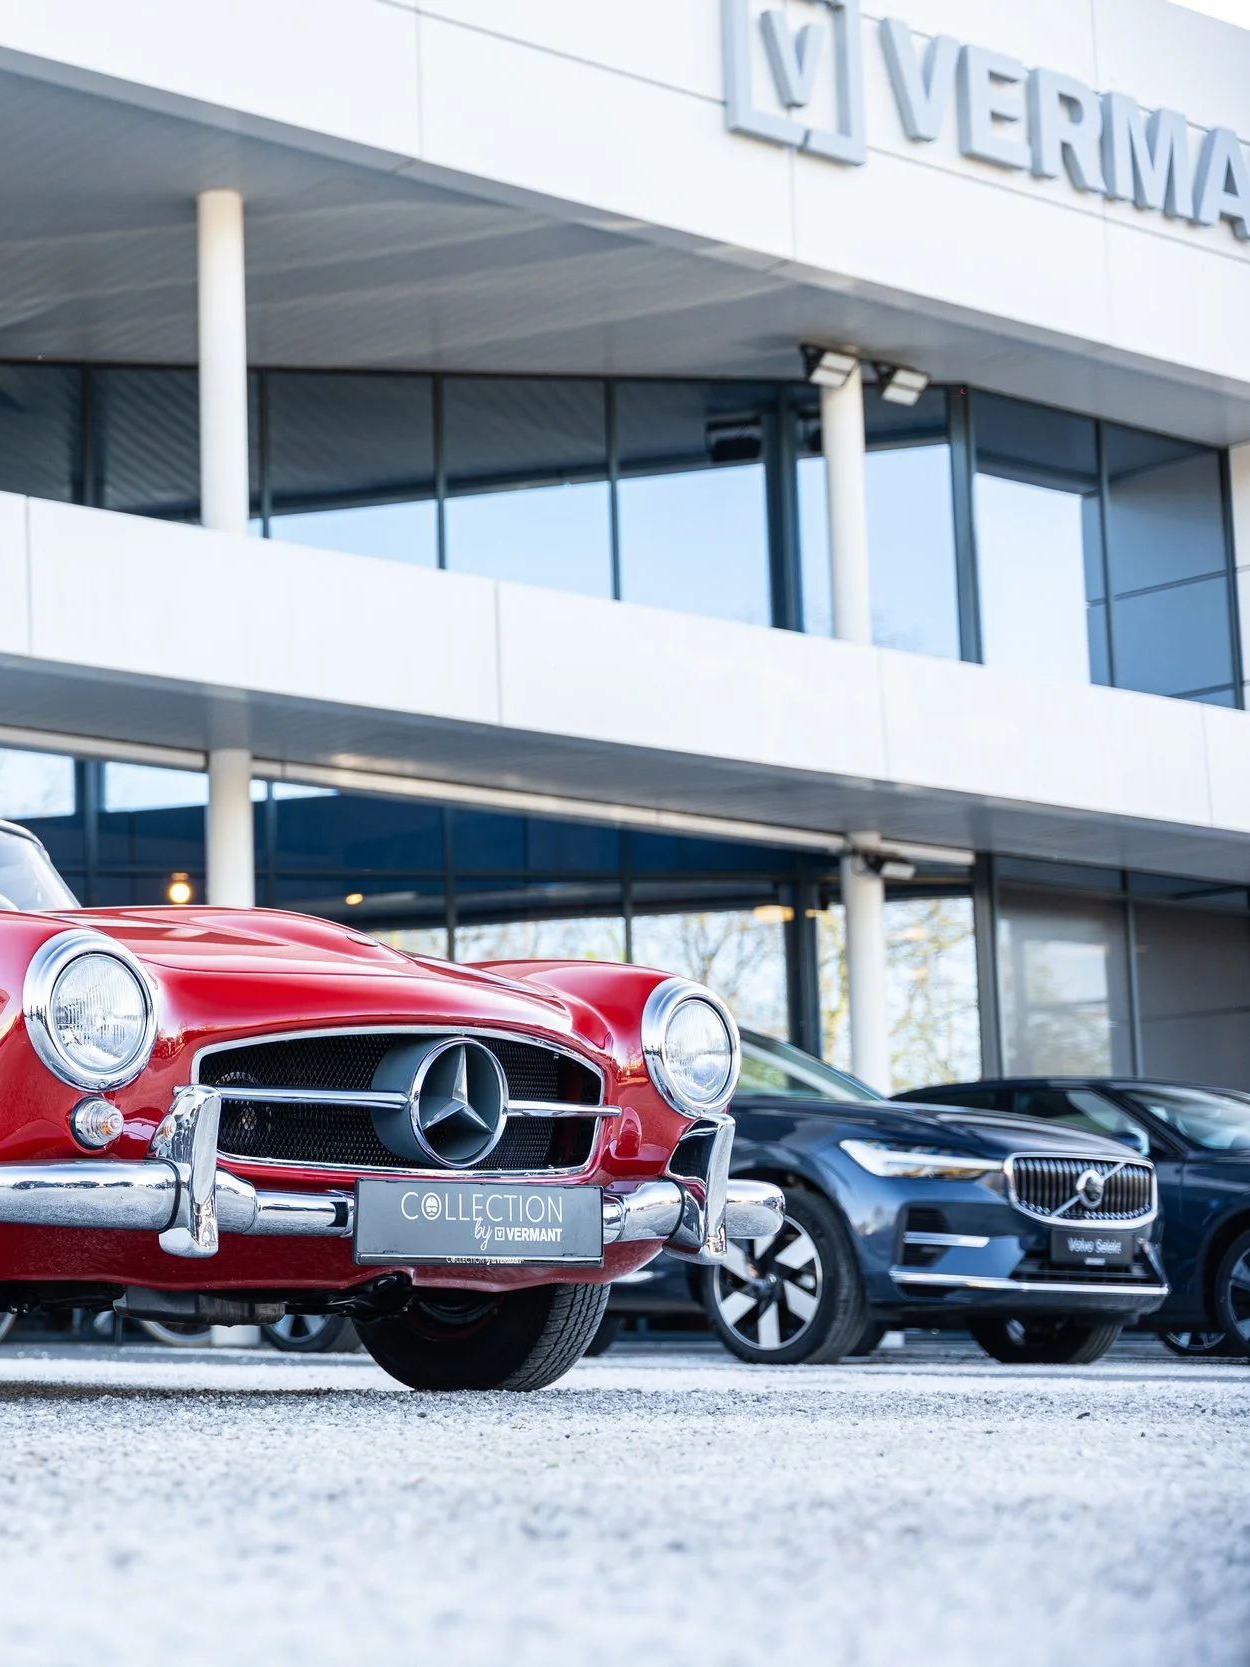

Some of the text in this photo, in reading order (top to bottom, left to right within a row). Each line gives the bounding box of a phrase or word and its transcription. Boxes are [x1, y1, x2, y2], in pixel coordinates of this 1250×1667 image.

[879, 17, 1250, 241] VERMA
[401, 1191, 564, 1224] COLLECTION
[473, 1216, 492, 1251] by
[507, 1227, 563, 1242] VERMANT
